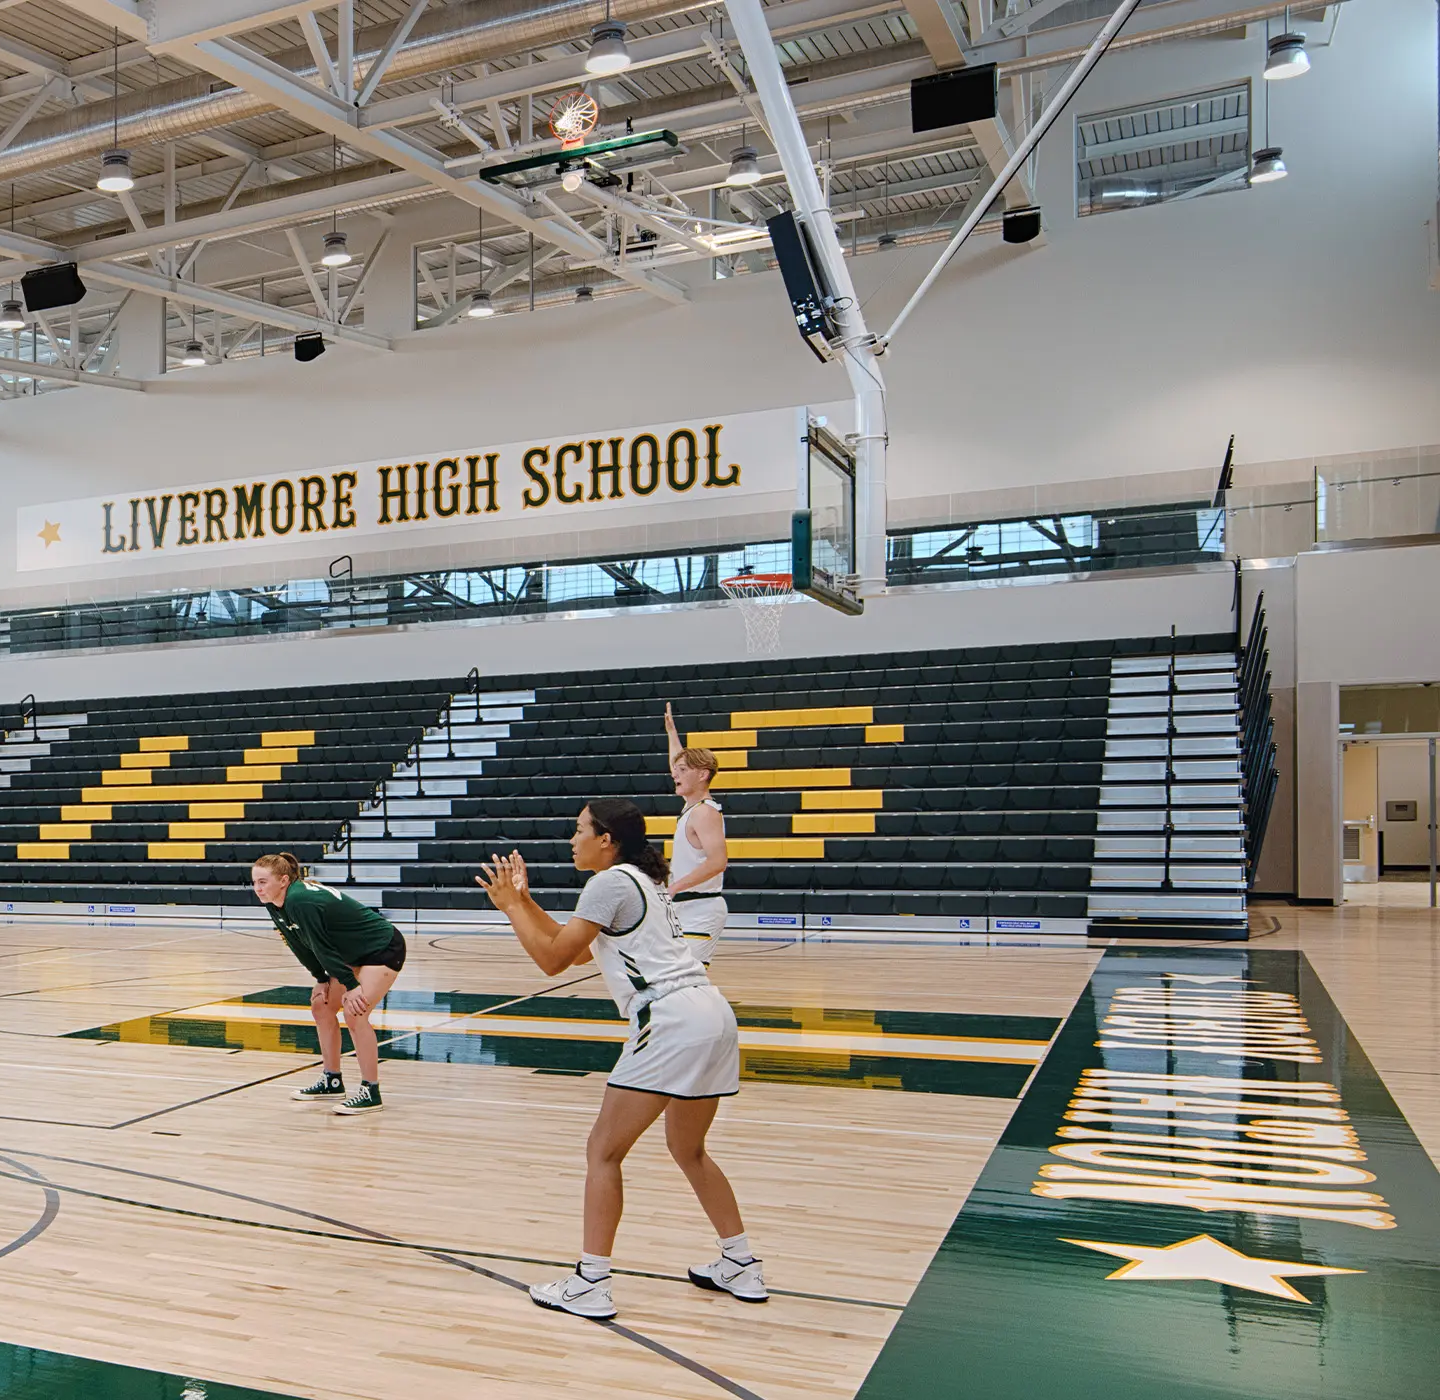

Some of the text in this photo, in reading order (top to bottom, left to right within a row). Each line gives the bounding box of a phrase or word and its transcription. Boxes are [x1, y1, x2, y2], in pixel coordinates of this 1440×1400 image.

[101, 423, 741, 555] LIVERMORE HIGH SCHOOL
[1030, 1068, 1398, 1230] NATION
